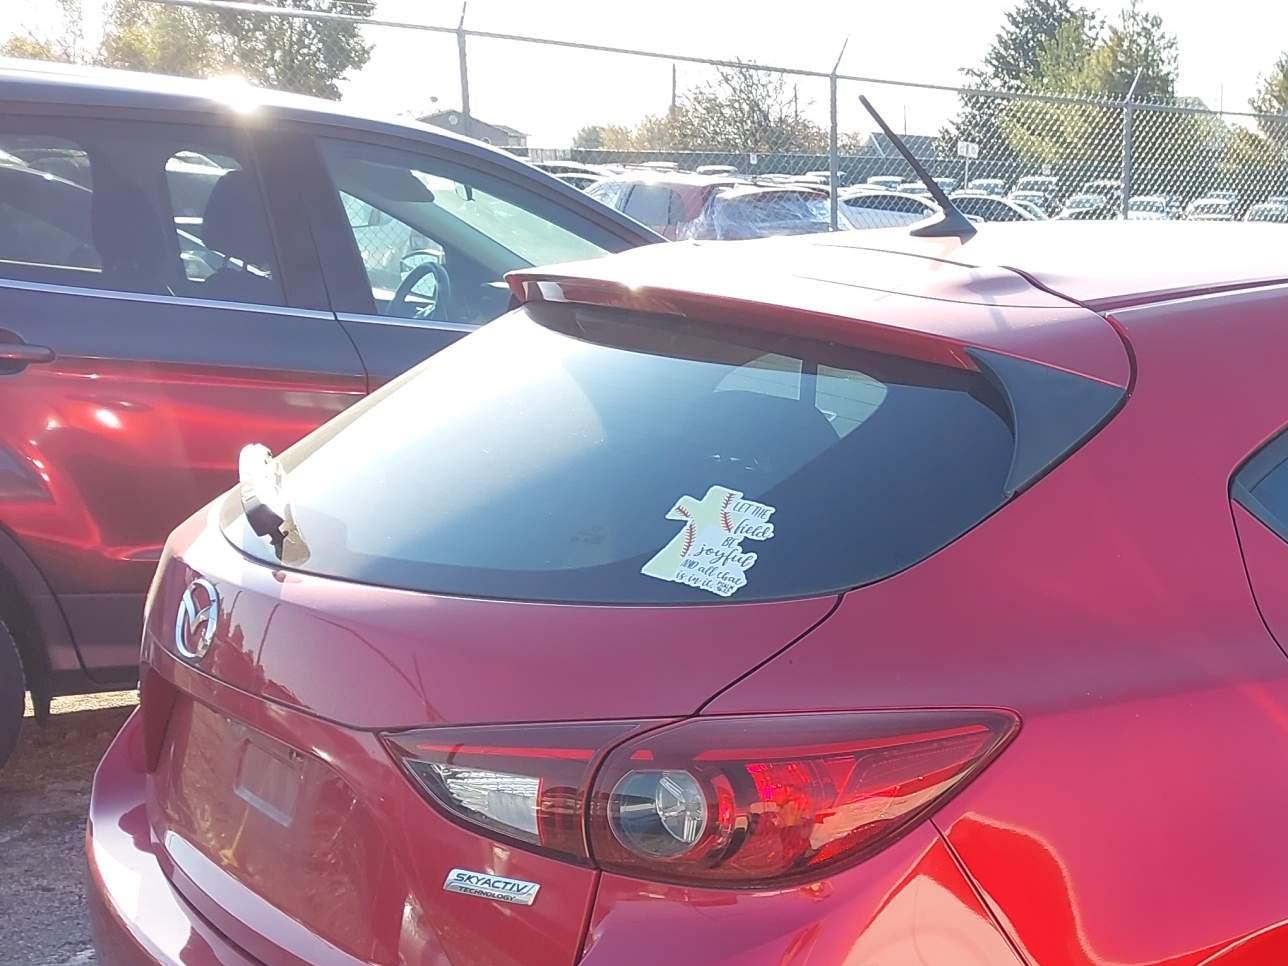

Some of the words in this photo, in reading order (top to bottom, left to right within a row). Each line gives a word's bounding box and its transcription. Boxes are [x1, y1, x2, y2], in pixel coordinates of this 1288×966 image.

[732, 501, 753, 514] LET
[733, 518, 771, 538] field
[722, 537, 738, 549] BE
[693, 543, 755, 568] joyful
[698, 566, 719, 577] all
[453, 872, 529, 893] SKYACTIV
[458, 886, 517, 901] TECHNOLOGY
